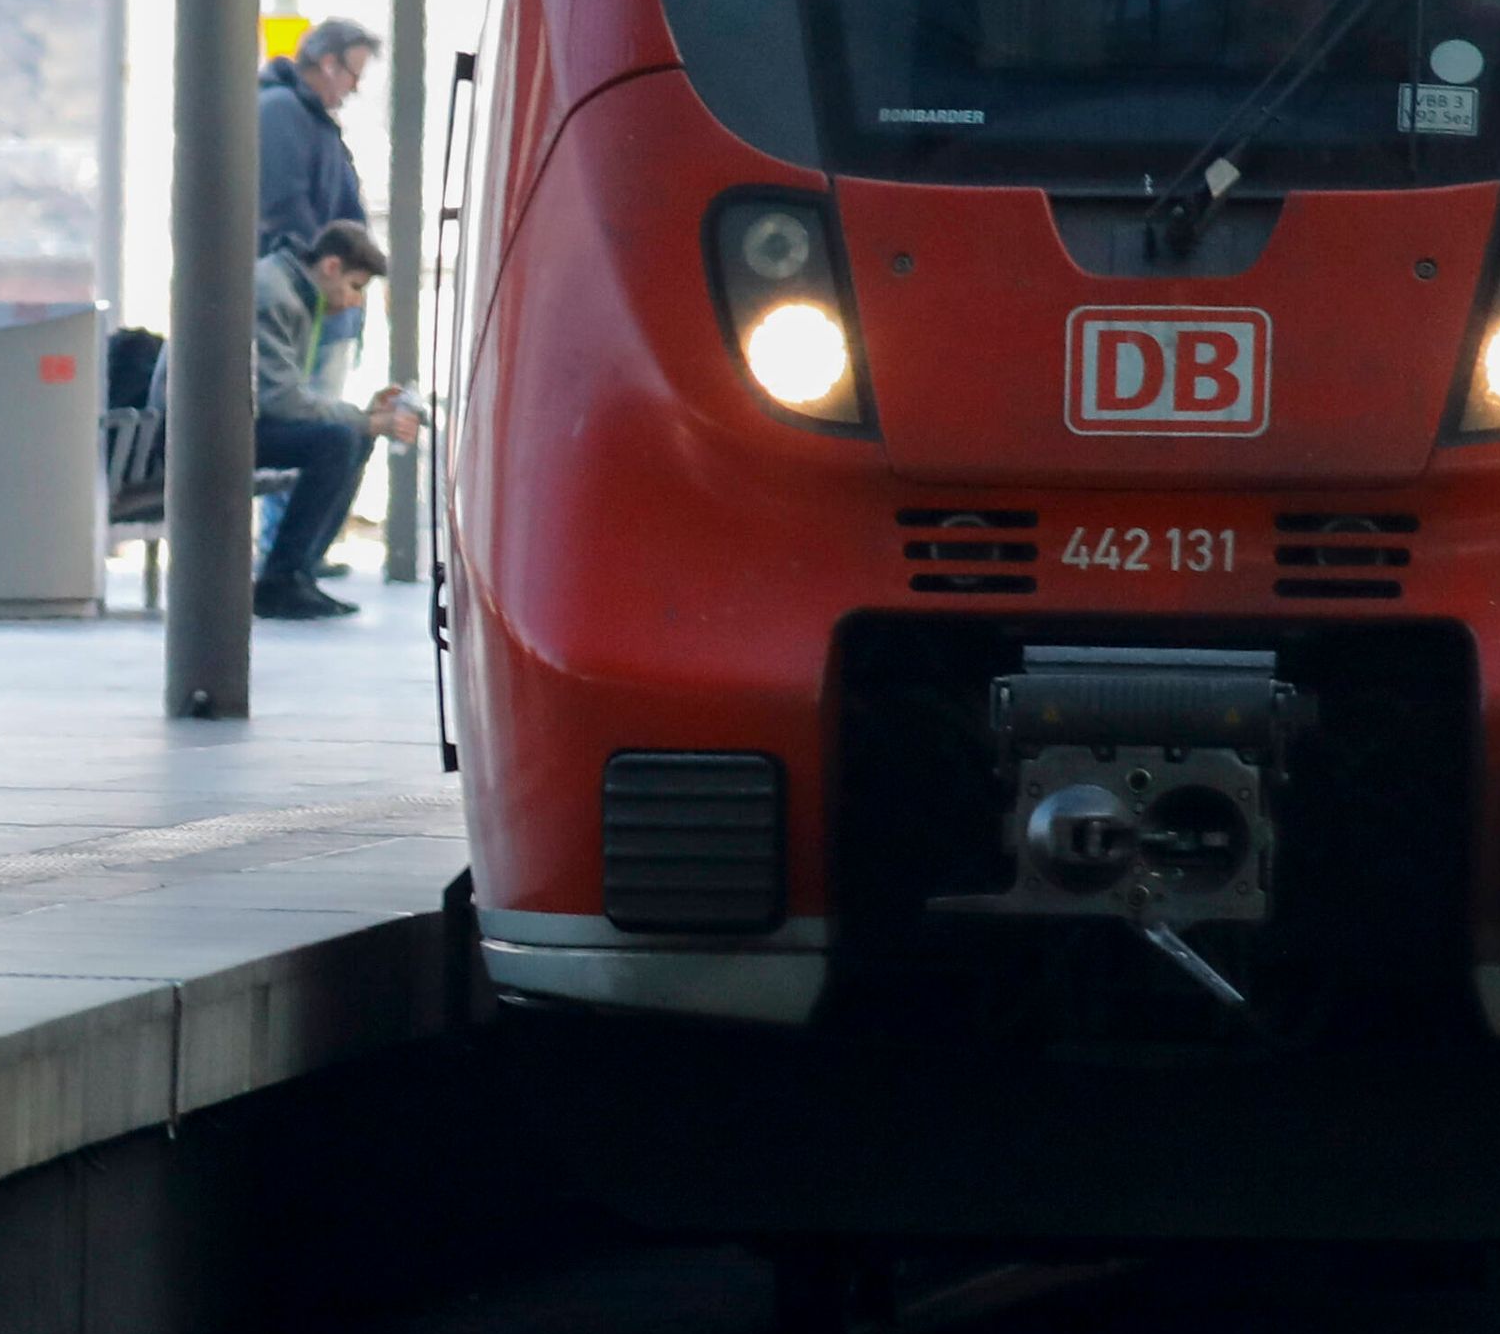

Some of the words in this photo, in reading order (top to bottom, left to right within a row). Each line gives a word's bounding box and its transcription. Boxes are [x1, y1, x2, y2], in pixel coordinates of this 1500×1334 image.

[879, 108, 985, 124] BOMBARDIER
[1096, 329, 1241, 413] DB
[1061, 526, 1151, 571] 442
[1165, 527, 1236, 572] 131
